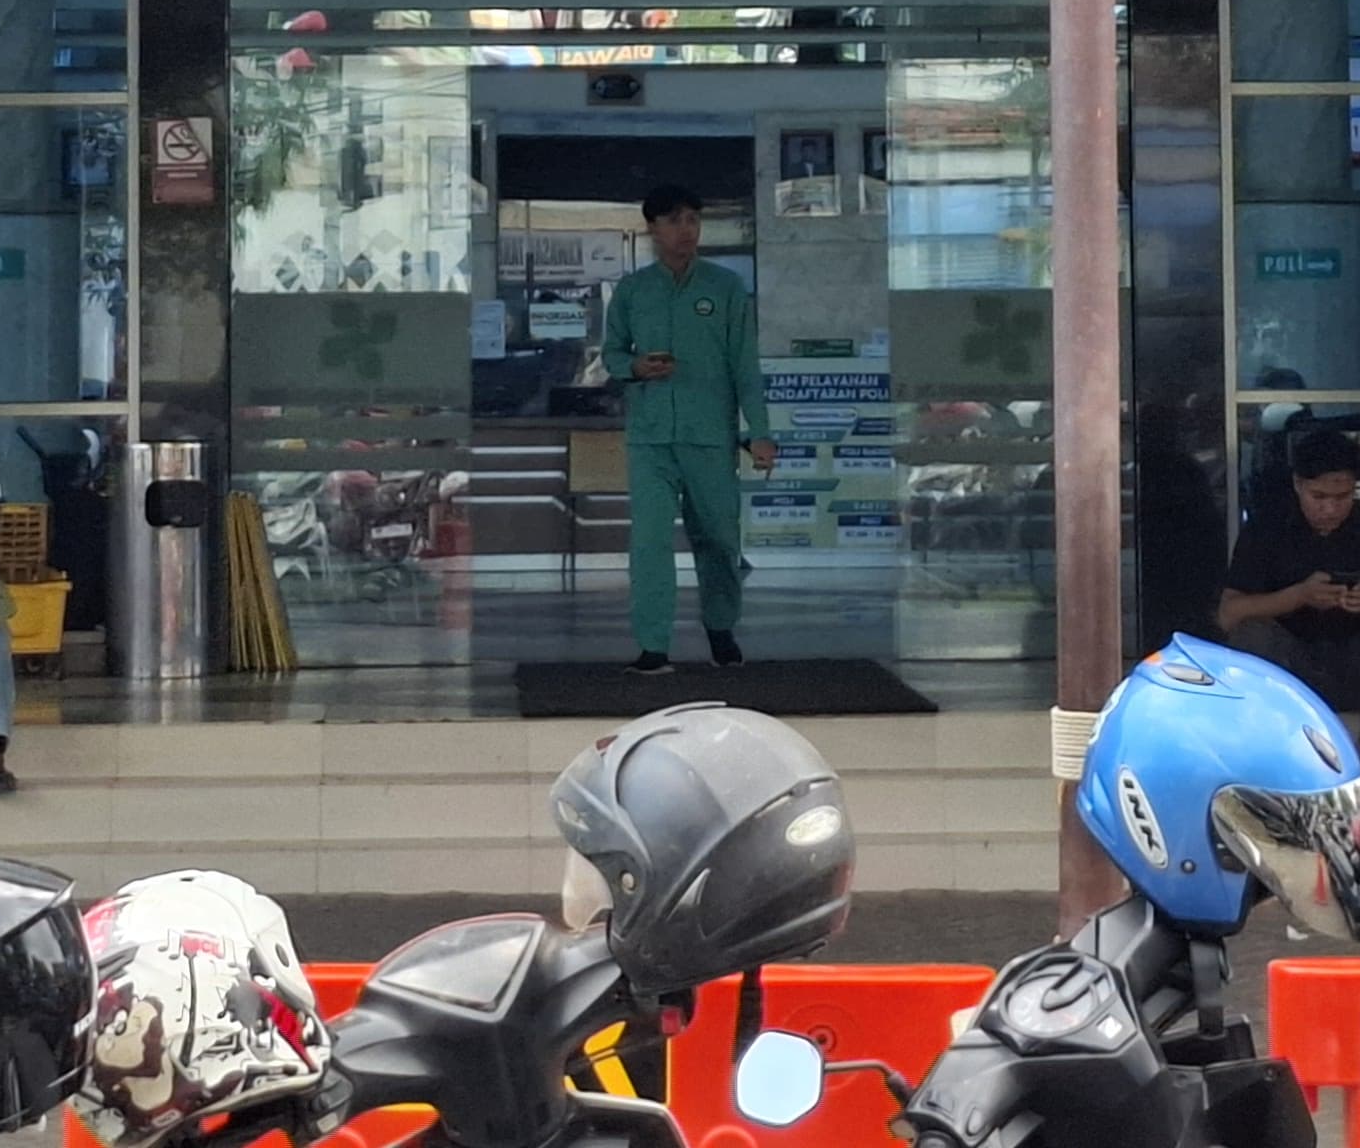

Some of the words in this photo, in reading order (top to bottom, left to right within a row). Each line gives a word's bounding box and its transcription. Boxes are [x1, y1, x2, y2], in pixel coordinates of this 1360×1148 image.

[770, 375, 798, 387] JAM
[801, 374, 879, 387] PELAYANAN
[1123, 778, 1161, 851] INK
